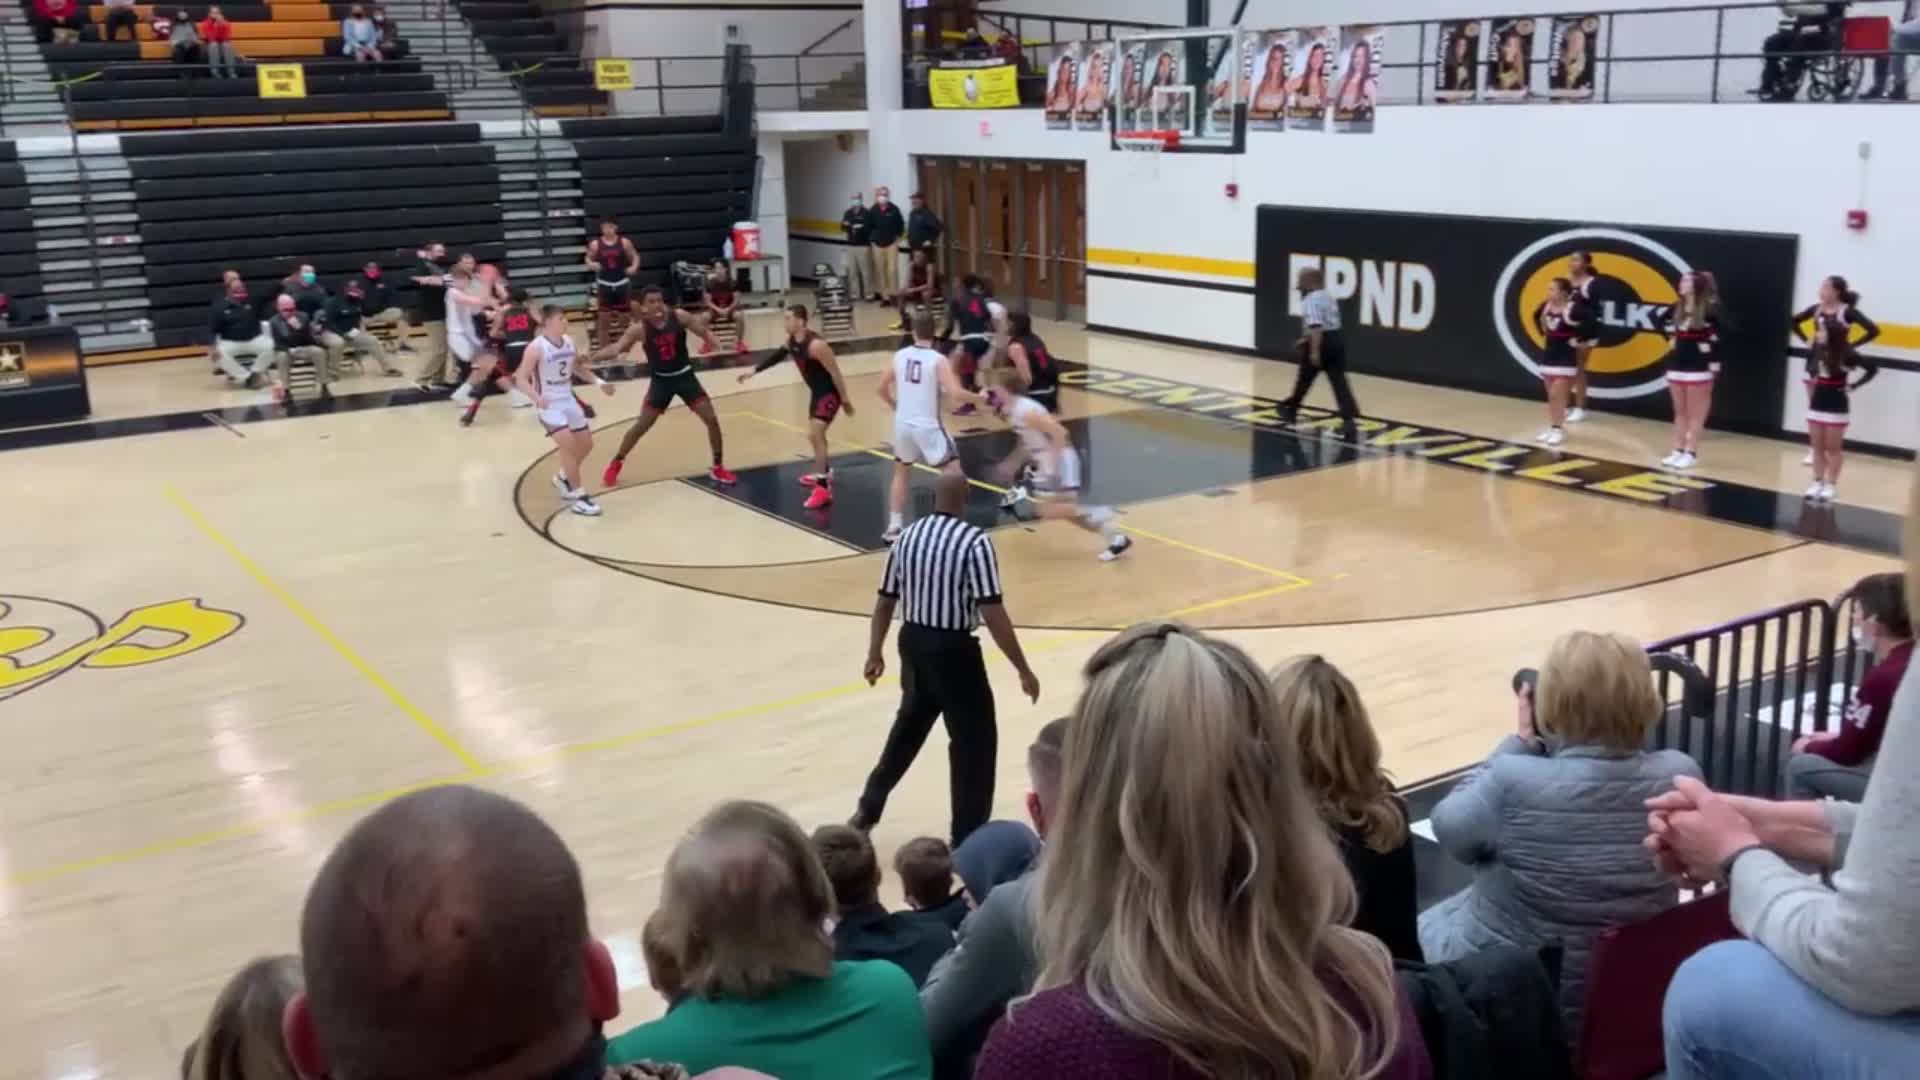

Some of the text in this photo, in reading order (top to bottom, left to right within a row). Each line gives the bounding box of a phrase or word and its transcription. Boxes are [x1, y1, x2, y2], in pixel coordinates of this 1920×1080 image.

[1597, 300, 1677, 332] LK
[558, 361, 568, 377] 2
[905, 358, 922, 384] 10
